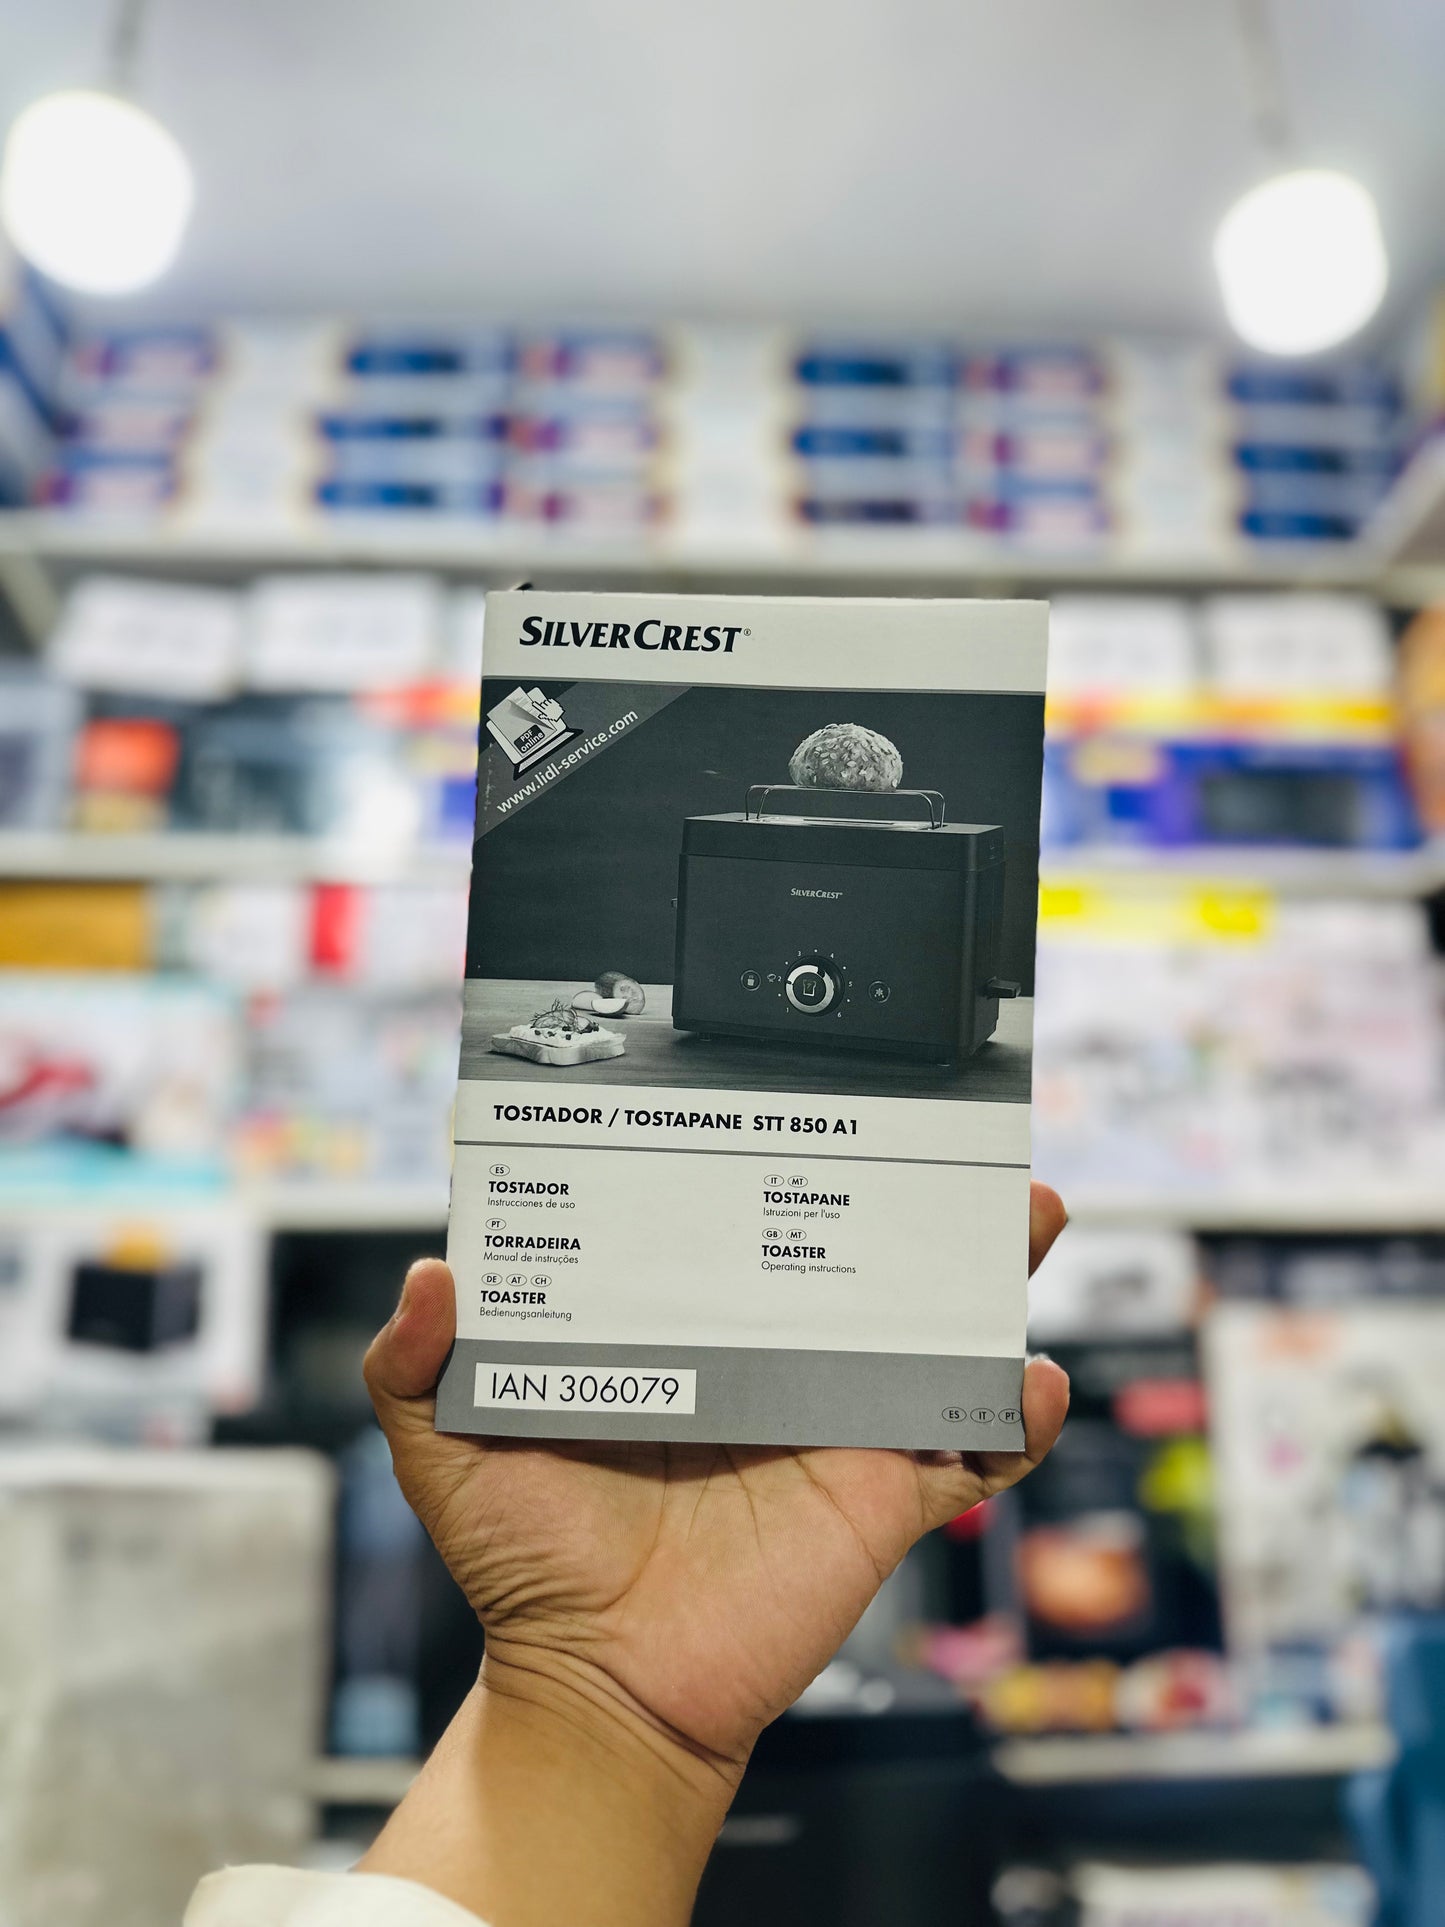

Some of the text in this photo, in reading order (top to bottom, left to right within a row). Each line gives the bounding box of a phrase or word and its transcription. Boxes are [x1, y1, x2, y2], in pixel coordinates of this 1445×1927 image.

[520, 729, 533, 743] PDF
[521, 732, 544, 753] online
[496, 710, 639, 813] www.lidl-service.com
[494, 1105, 856, 1134] TOSTADOR / TOSTAPANE STT 850 A1
[488, 1181, 569, 1196] TOSTADOR
[487, 1197, 575, 1209] Instrucciones de uso
[764, 1191, 849, 1206] TOSTAPANE
[764, 1207, 841, 1220] Istruzioni per l'uso
[485, 1235, 580, 1251] TORRADEIRA
[484, 1252, 578, 1264] Manual de instruções
[762, 1245, 826, 1259] TOASTER
[761, 1261, 858, 1275] Operating instructions
[481, 1291, 546, 1305] TOASTER
[480, 1307, 571, 1321] Bedienungsanleitung
[493, 1373, 679, 1404] IAN 306079
